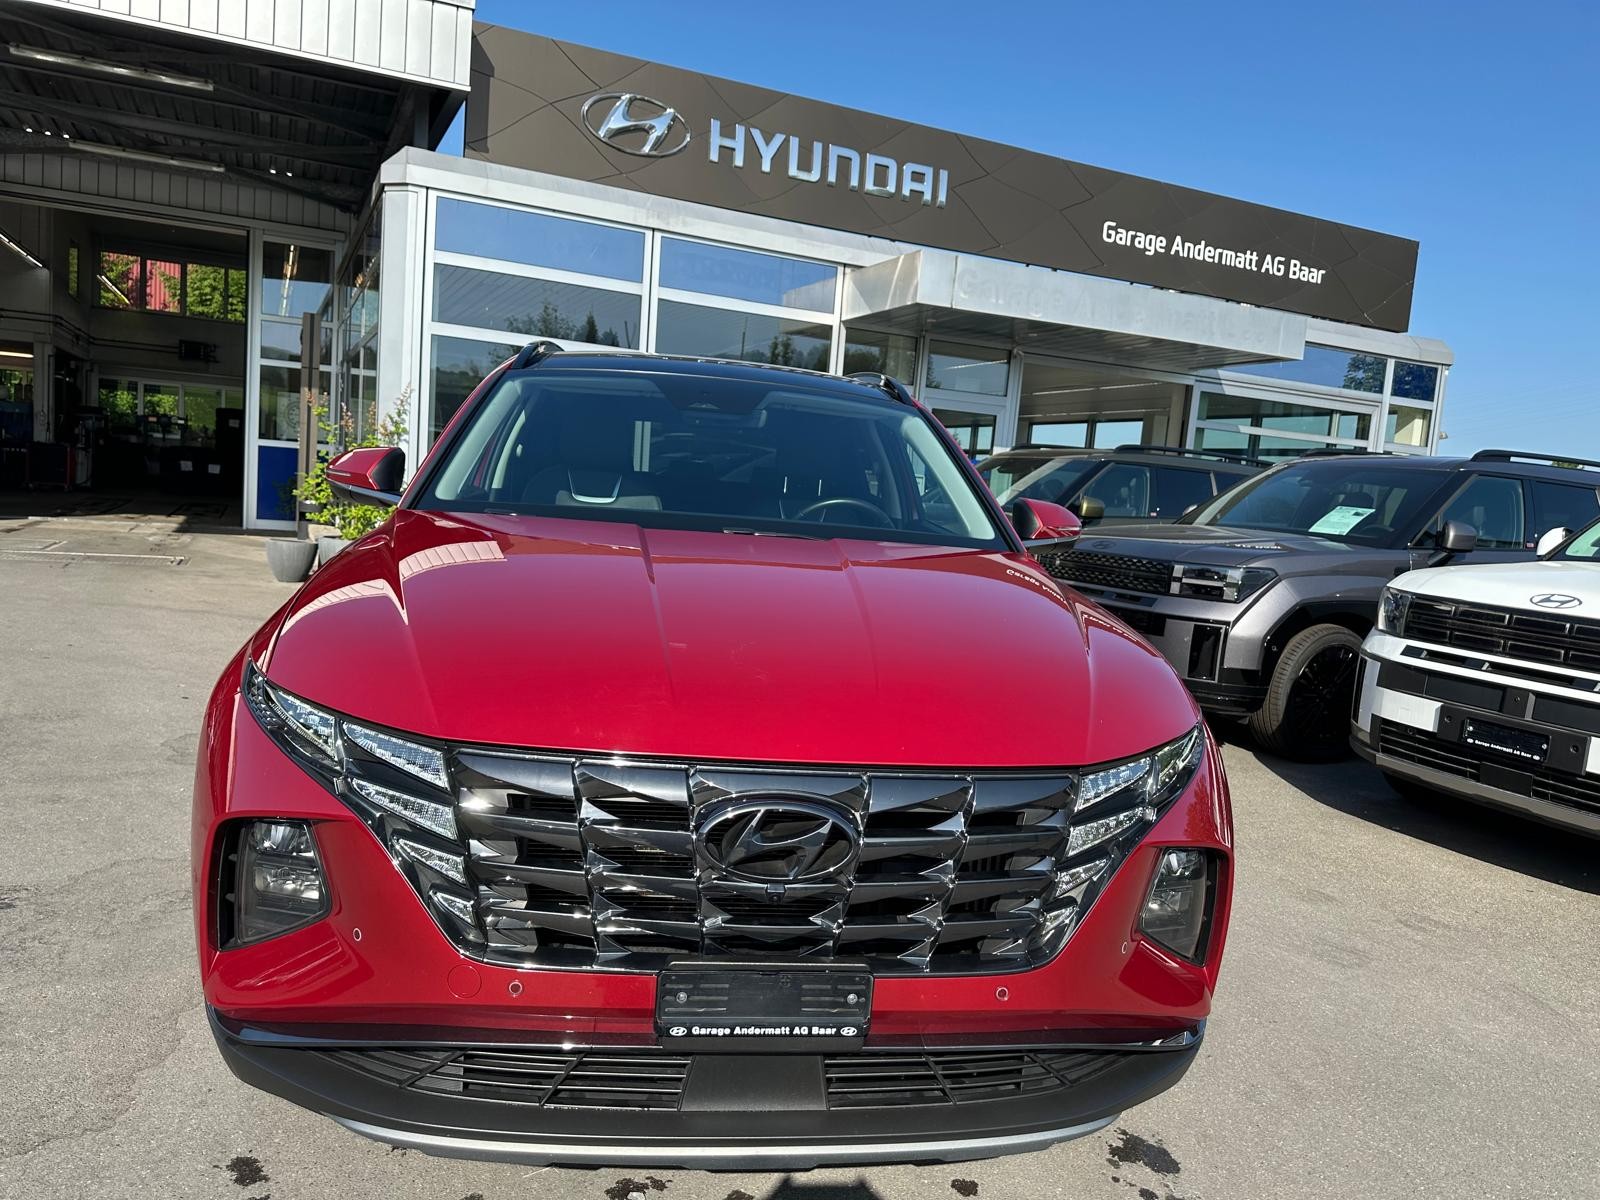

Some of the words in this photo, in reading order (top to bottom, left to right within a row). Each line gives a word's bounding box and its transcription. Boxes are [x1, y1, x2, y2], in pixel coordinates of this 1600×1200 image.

[709, 118, 949, 209] HYUNDAI
[1102, 221, 1167, 256] Garage
[1170, 235, 1258, 272] Andermatt
[1261, 254, 1285, 277] AG
[1289, 259, 1327, 285] Baar
[692, 1026, 731, 1036] Garage
[734, 1026, 790, 1035] Andermatt
[793, 1026, 808, 1035] AG
[811, 1026, 837, 1035] Baar
